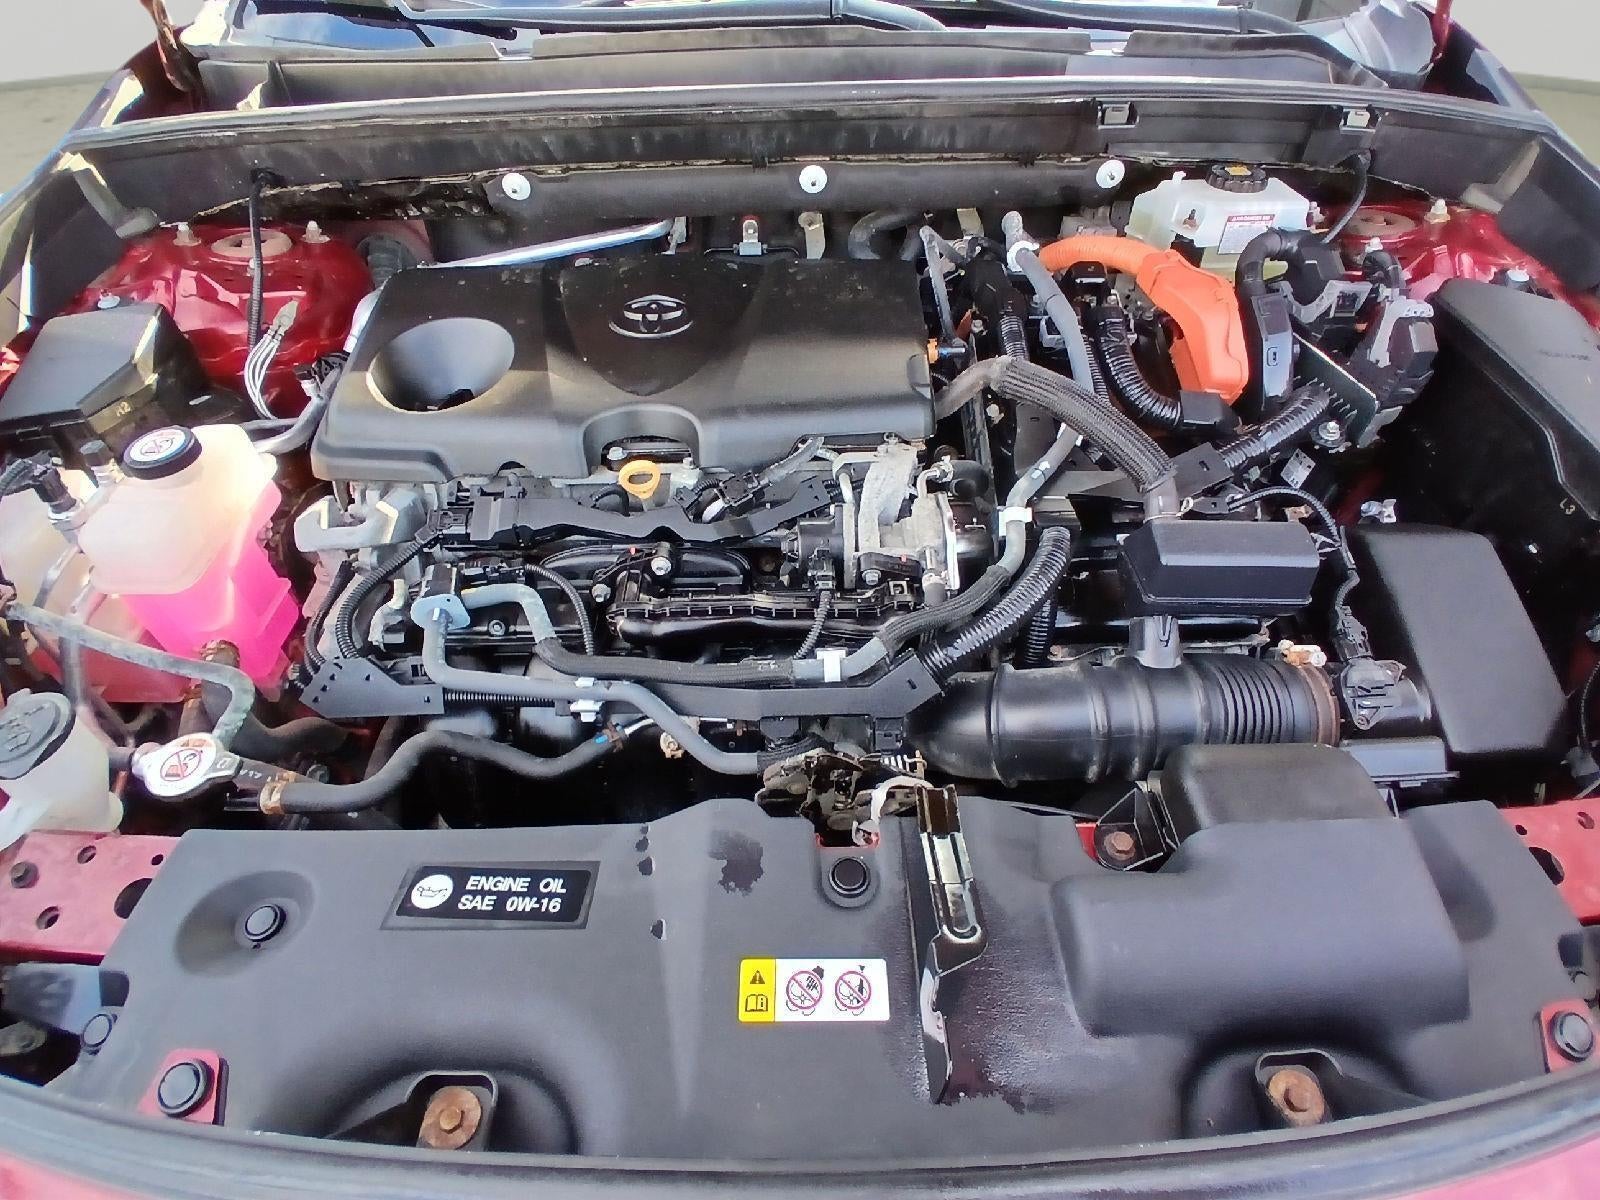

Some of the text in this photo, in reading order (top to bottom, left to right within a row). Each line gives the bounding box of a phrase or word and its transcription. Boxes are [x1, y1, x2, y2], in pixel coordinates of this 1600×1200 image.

[466, 875, 567, 893] ENGINE OIL
[458, 894, 562, 913] SAE 0W-16
